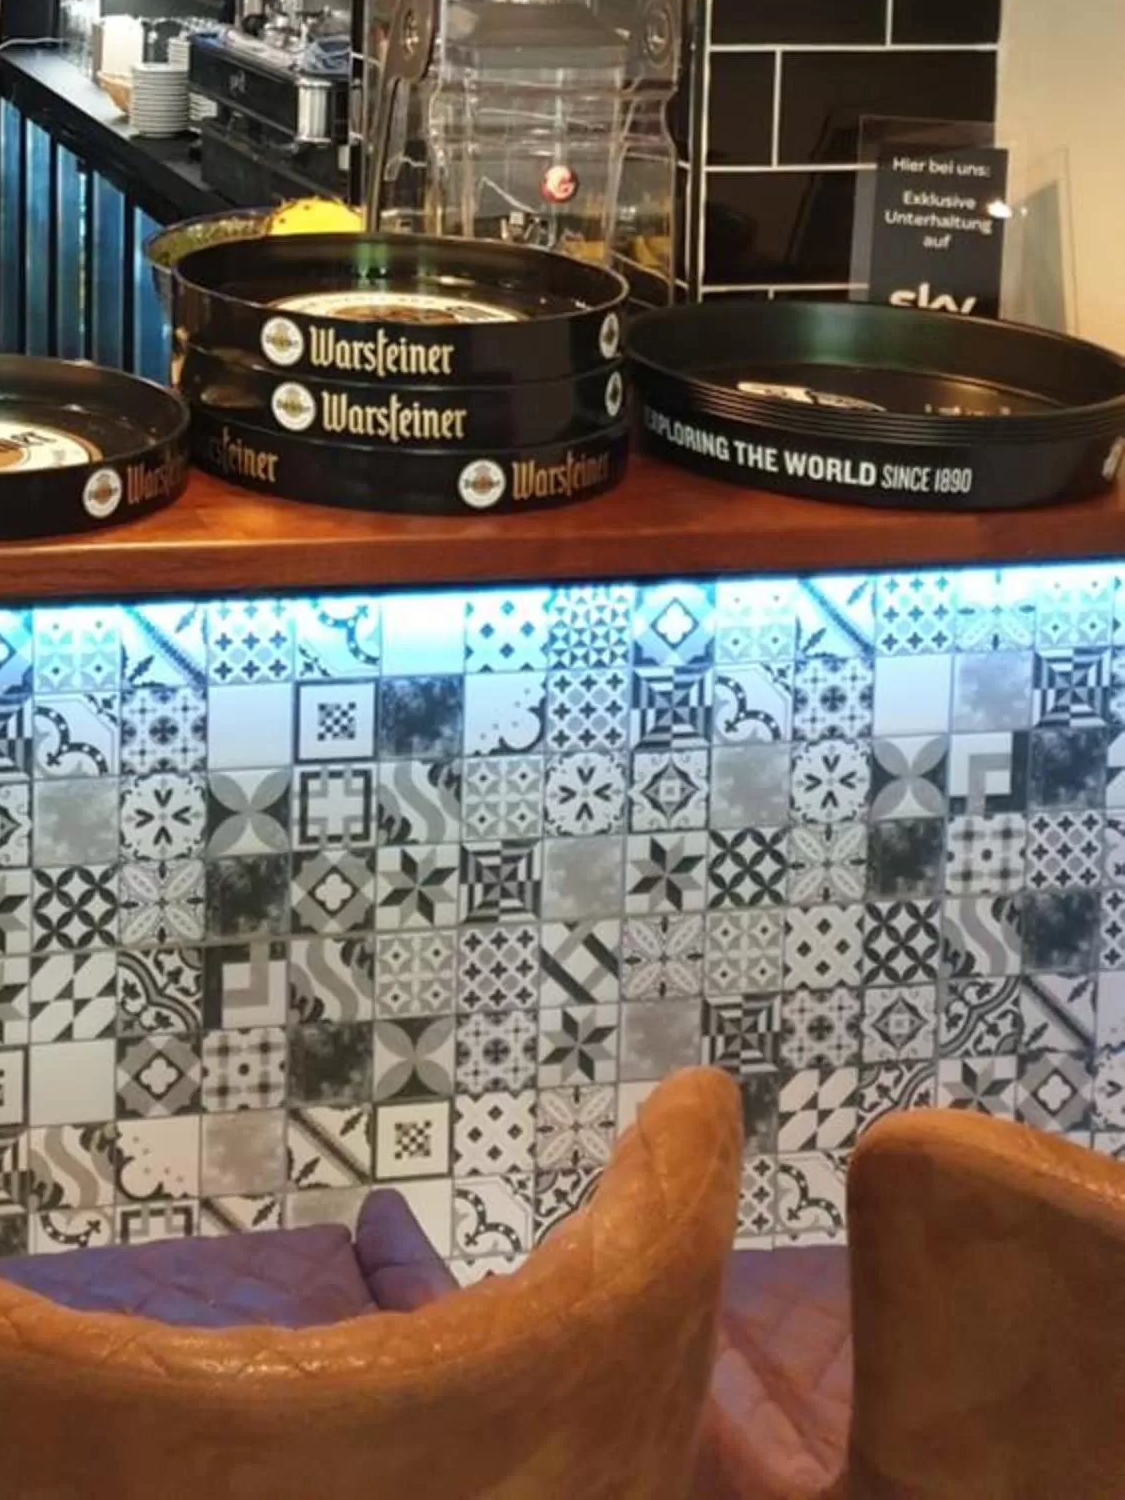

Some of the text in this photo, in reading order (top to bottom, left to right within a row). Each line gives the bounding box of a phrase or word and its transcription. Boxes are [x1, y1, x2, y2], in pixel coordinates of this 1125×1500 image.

[893, 156, 991, 178] Hier bei uns:
[903, 190, 976, 210] Exklusive
[885, 209, 993, 235] Unterhaltung
[923, 234, 951, 249] auf
[309, 324, 455, 377] Warsteiner
[321, 389, 467, 443] Warsteiner
[644, 403, 730, 461] EXPLORING
[732, 440, 779, 473] THE
[782, 450, 876, 487] WORLD
[881, 463, 931, 492] SINCE
